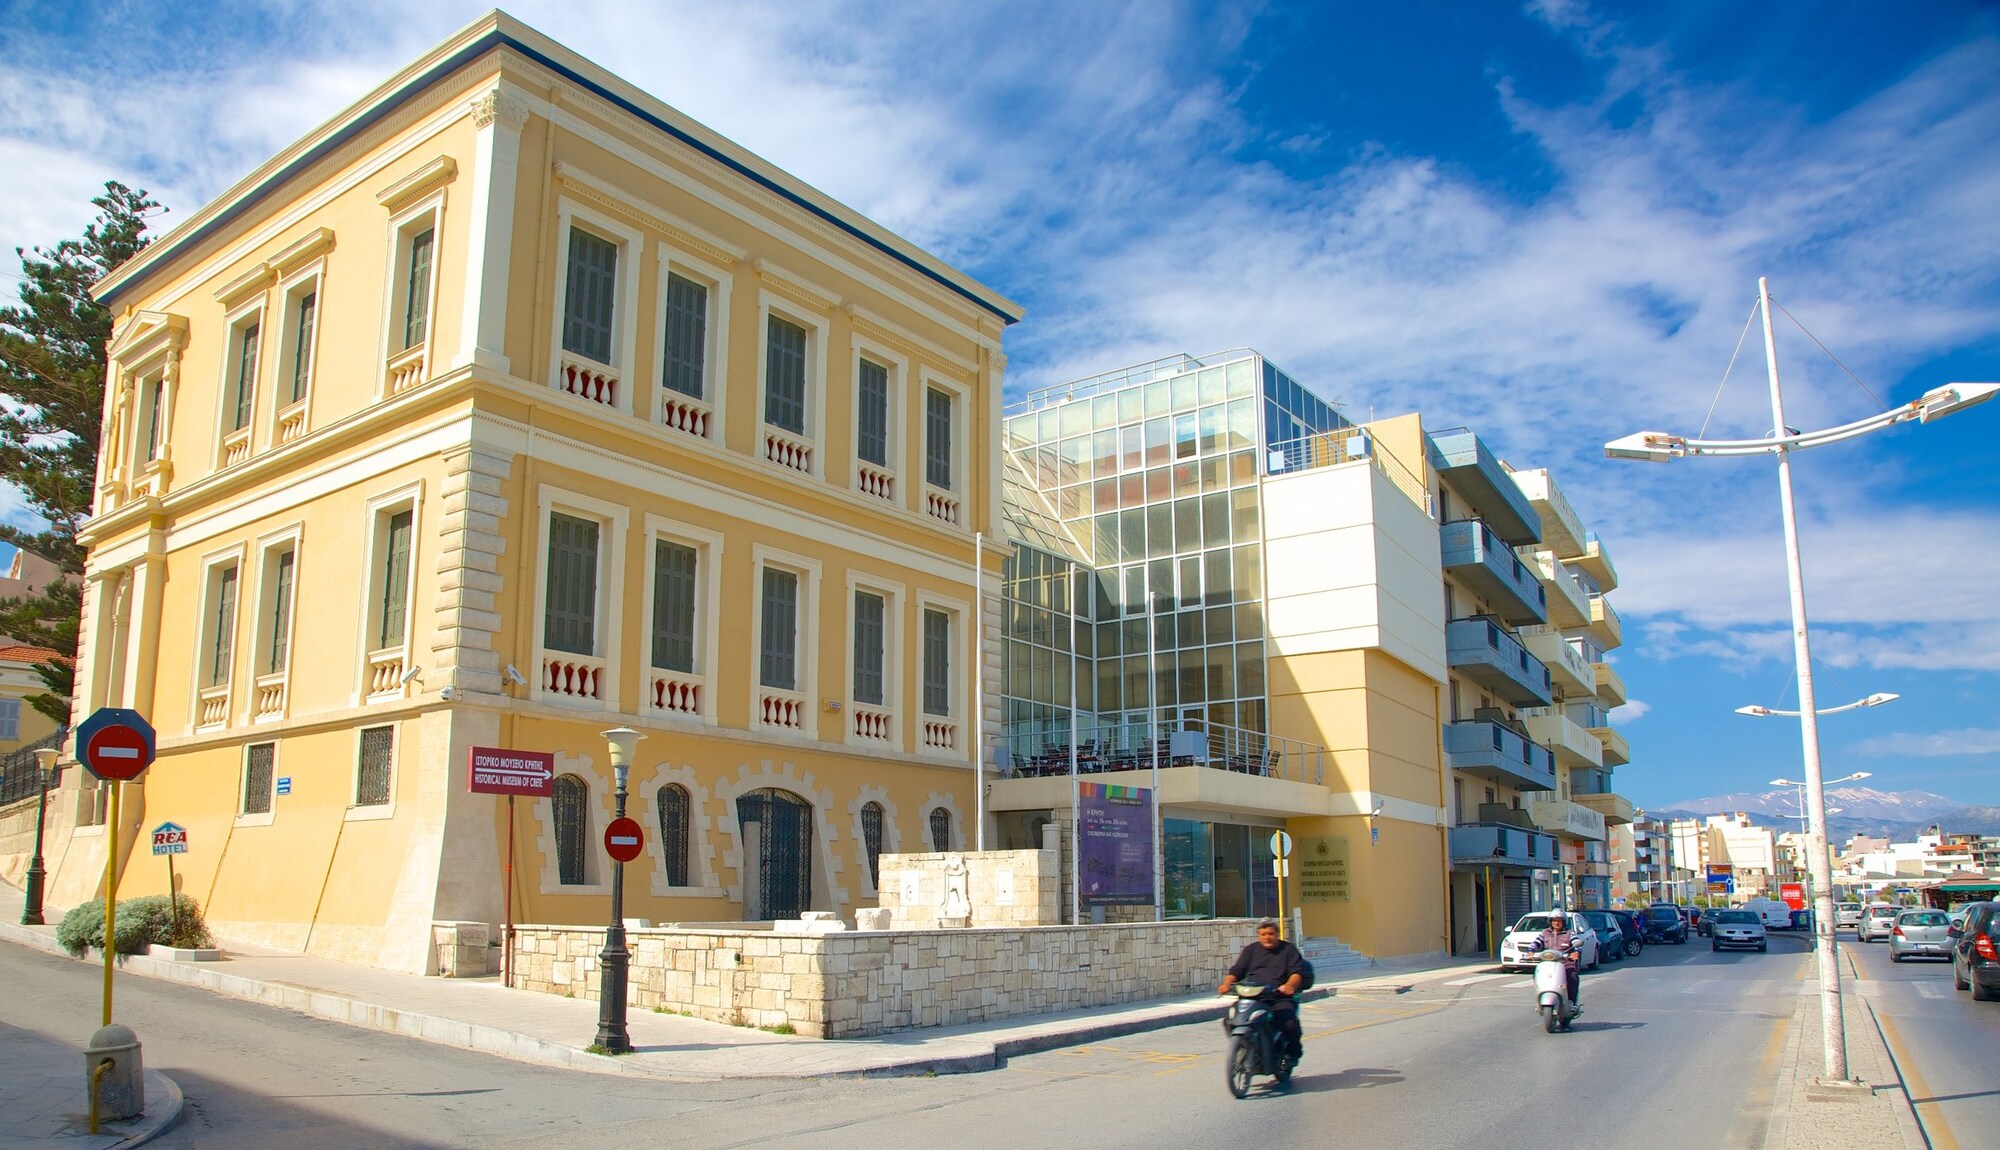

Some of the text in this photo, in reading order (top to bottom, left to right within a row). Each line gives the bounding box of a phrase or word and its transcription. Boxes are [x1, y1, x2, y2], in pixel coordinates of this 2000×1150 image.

[475, 773, 543, 788] HISTORICAL MUSEUM OF CRETE
[153, 831, 187, 845] REA
[153, 844, 187, 855] HOTEL
